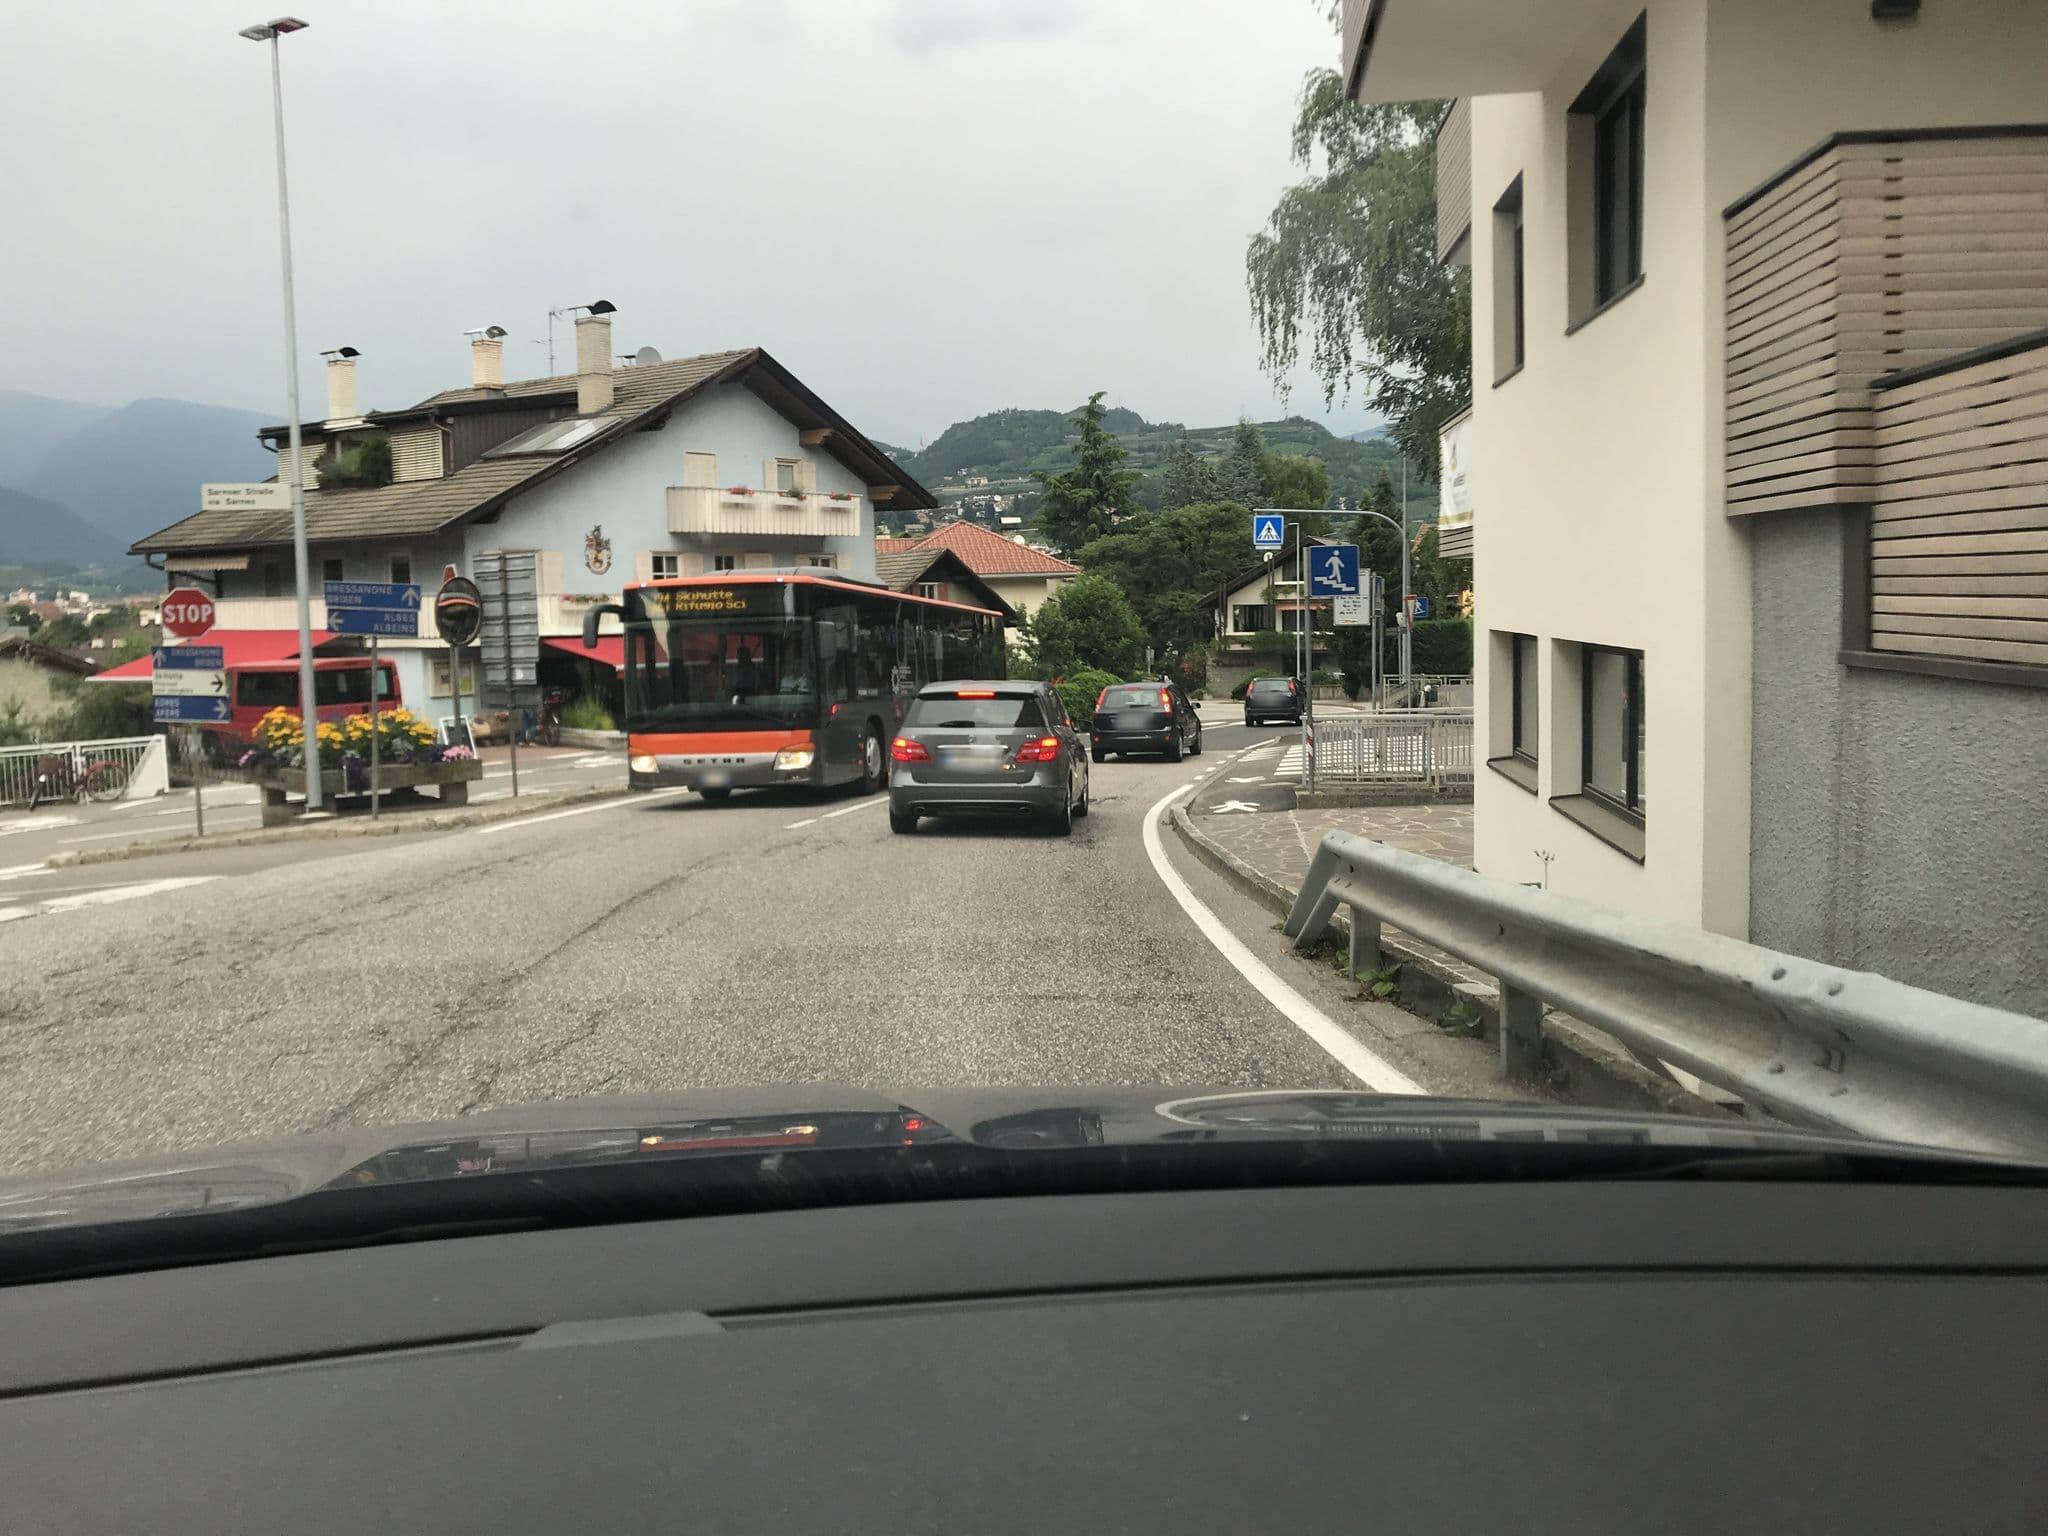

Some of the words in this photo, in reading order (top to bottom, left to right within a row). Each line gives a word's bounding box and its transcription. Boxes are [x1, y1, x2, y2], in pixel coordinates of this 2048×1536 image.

[326, 584, 393, 596] BRESSANONE
[675, 600, 723, 610] Rifugio
[164, 603, 213, 624] STOP
[373, 622, 416, 633] ALBEINS
[683, 757, 745, 765] SETRA
